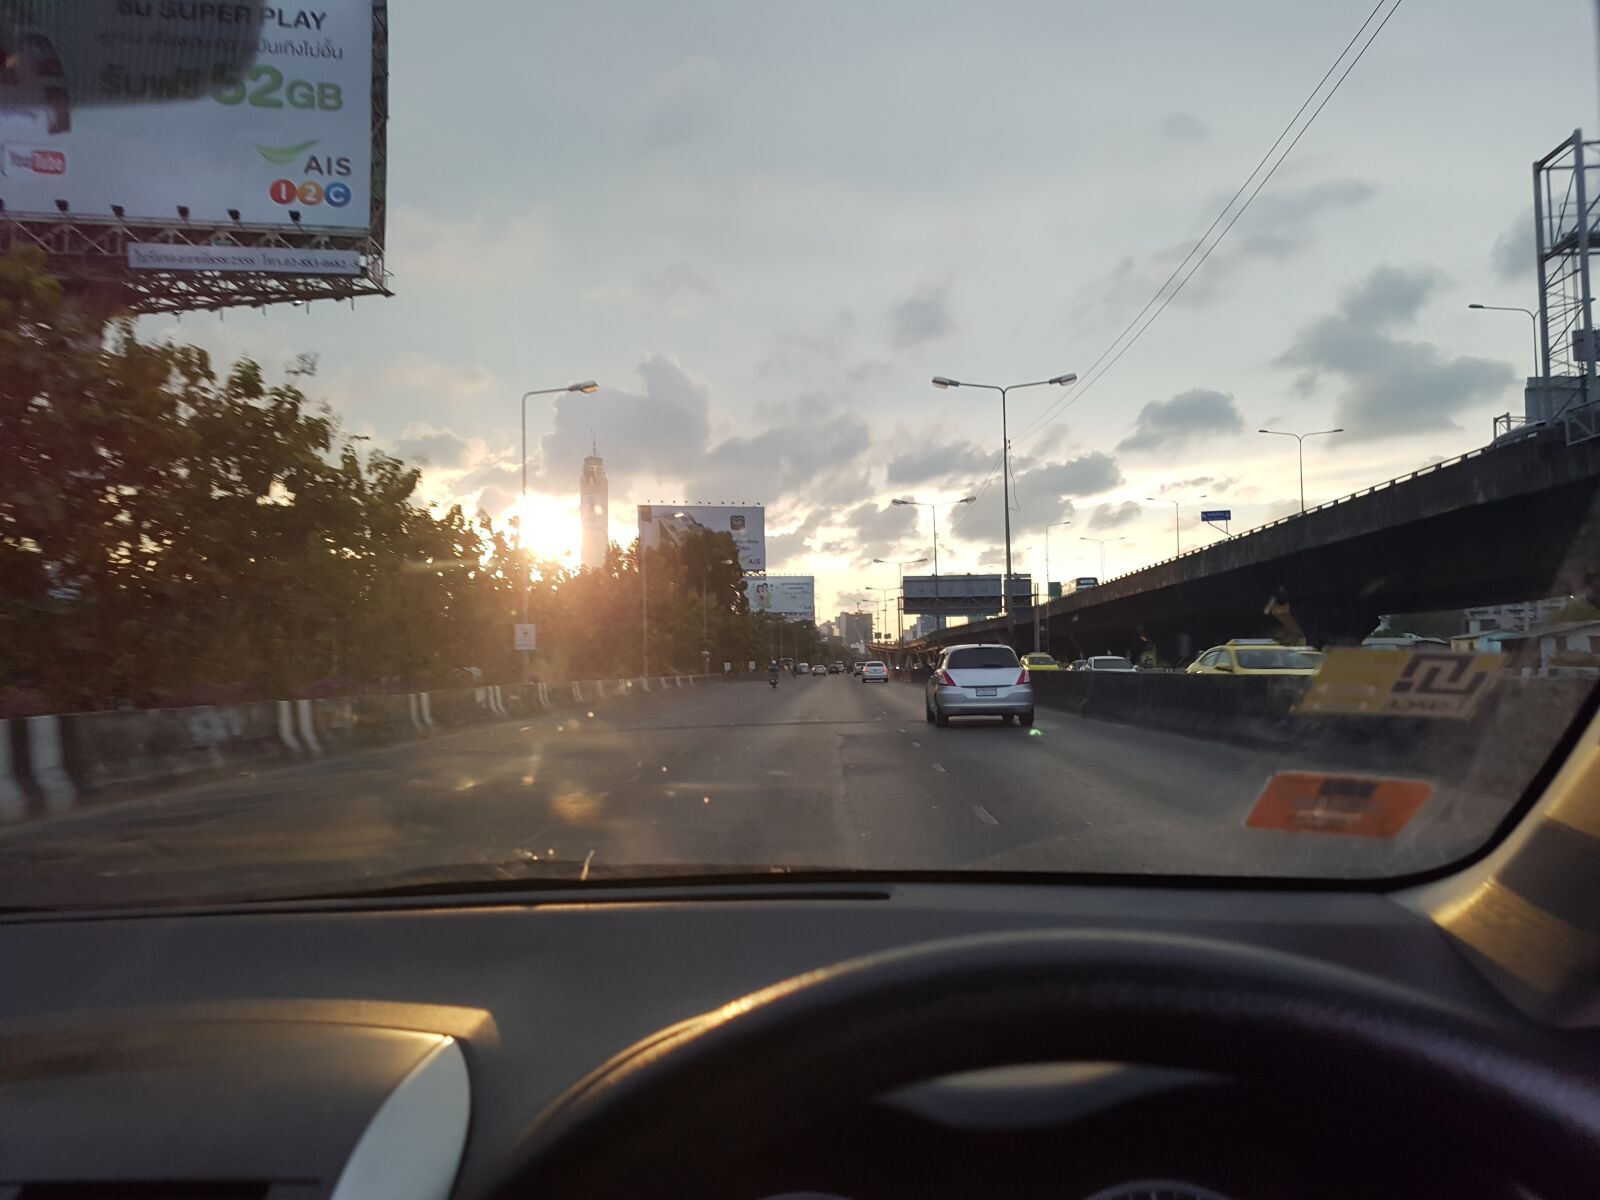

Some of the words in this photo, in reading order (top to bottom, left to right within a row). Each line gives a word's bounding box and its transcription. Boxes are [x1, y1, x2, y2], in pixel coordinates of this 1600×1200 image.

[158, 0, 251, 24] SUPER
[261, 8, 328, 31] PLAY
[304, 154, 352, 177] AIS
